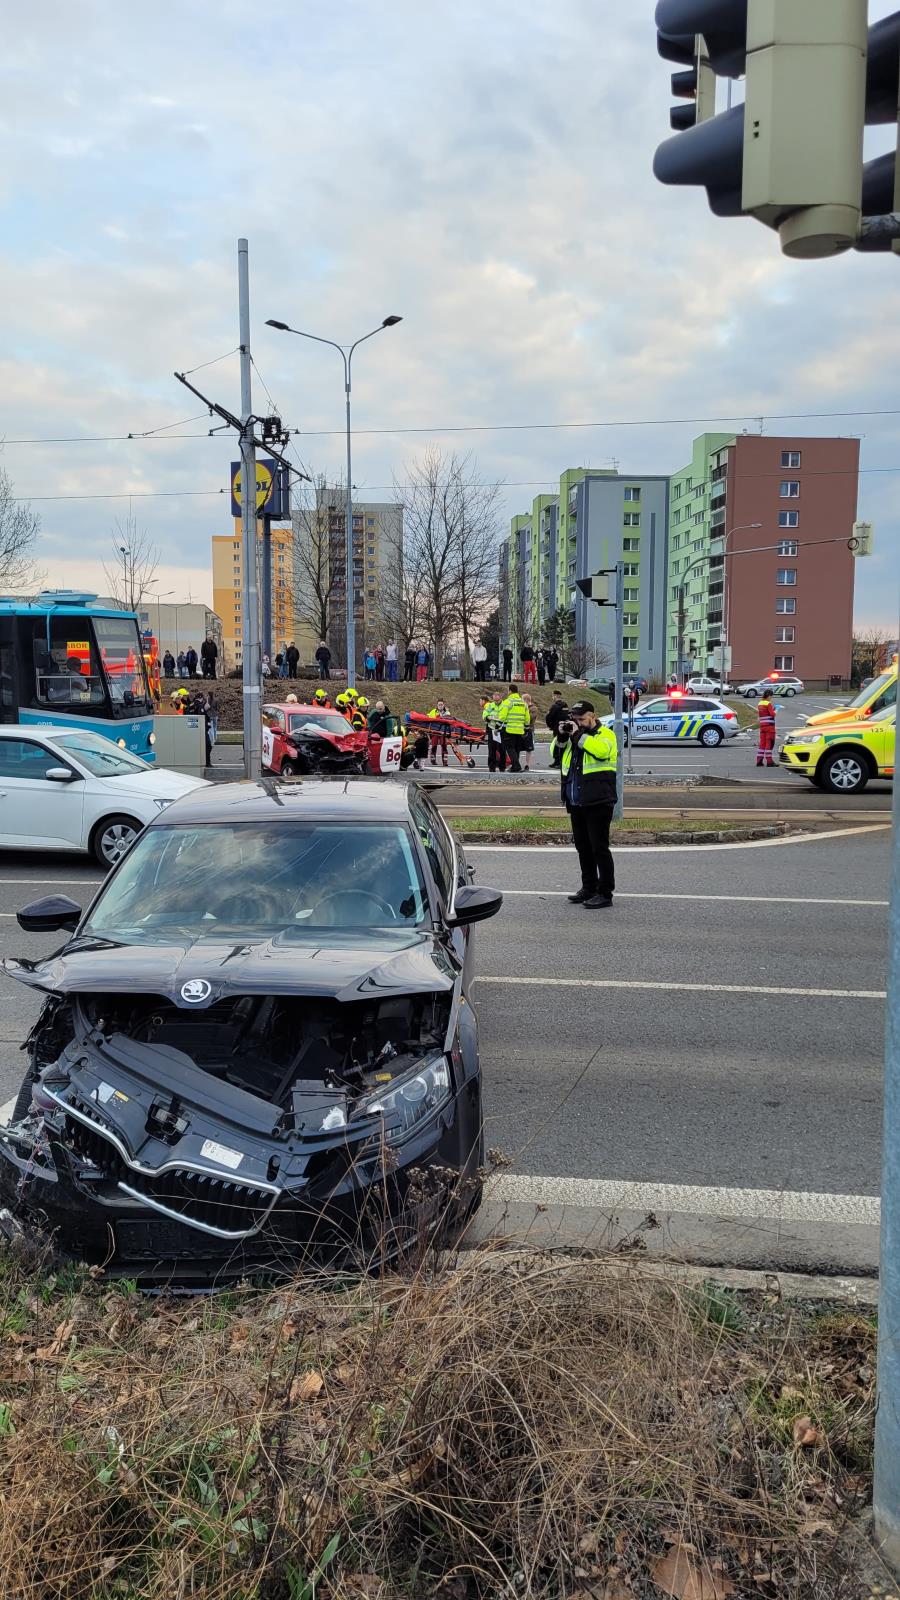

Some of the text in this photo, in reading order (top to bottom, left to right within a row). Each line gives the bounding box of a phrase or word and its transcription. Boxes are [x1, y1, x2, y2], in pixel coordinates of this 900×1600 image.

[236, 481, 269, 492] LDL
[636, 724, 669, 732] POLICIE
[386, 748, 401, 762] Bo
